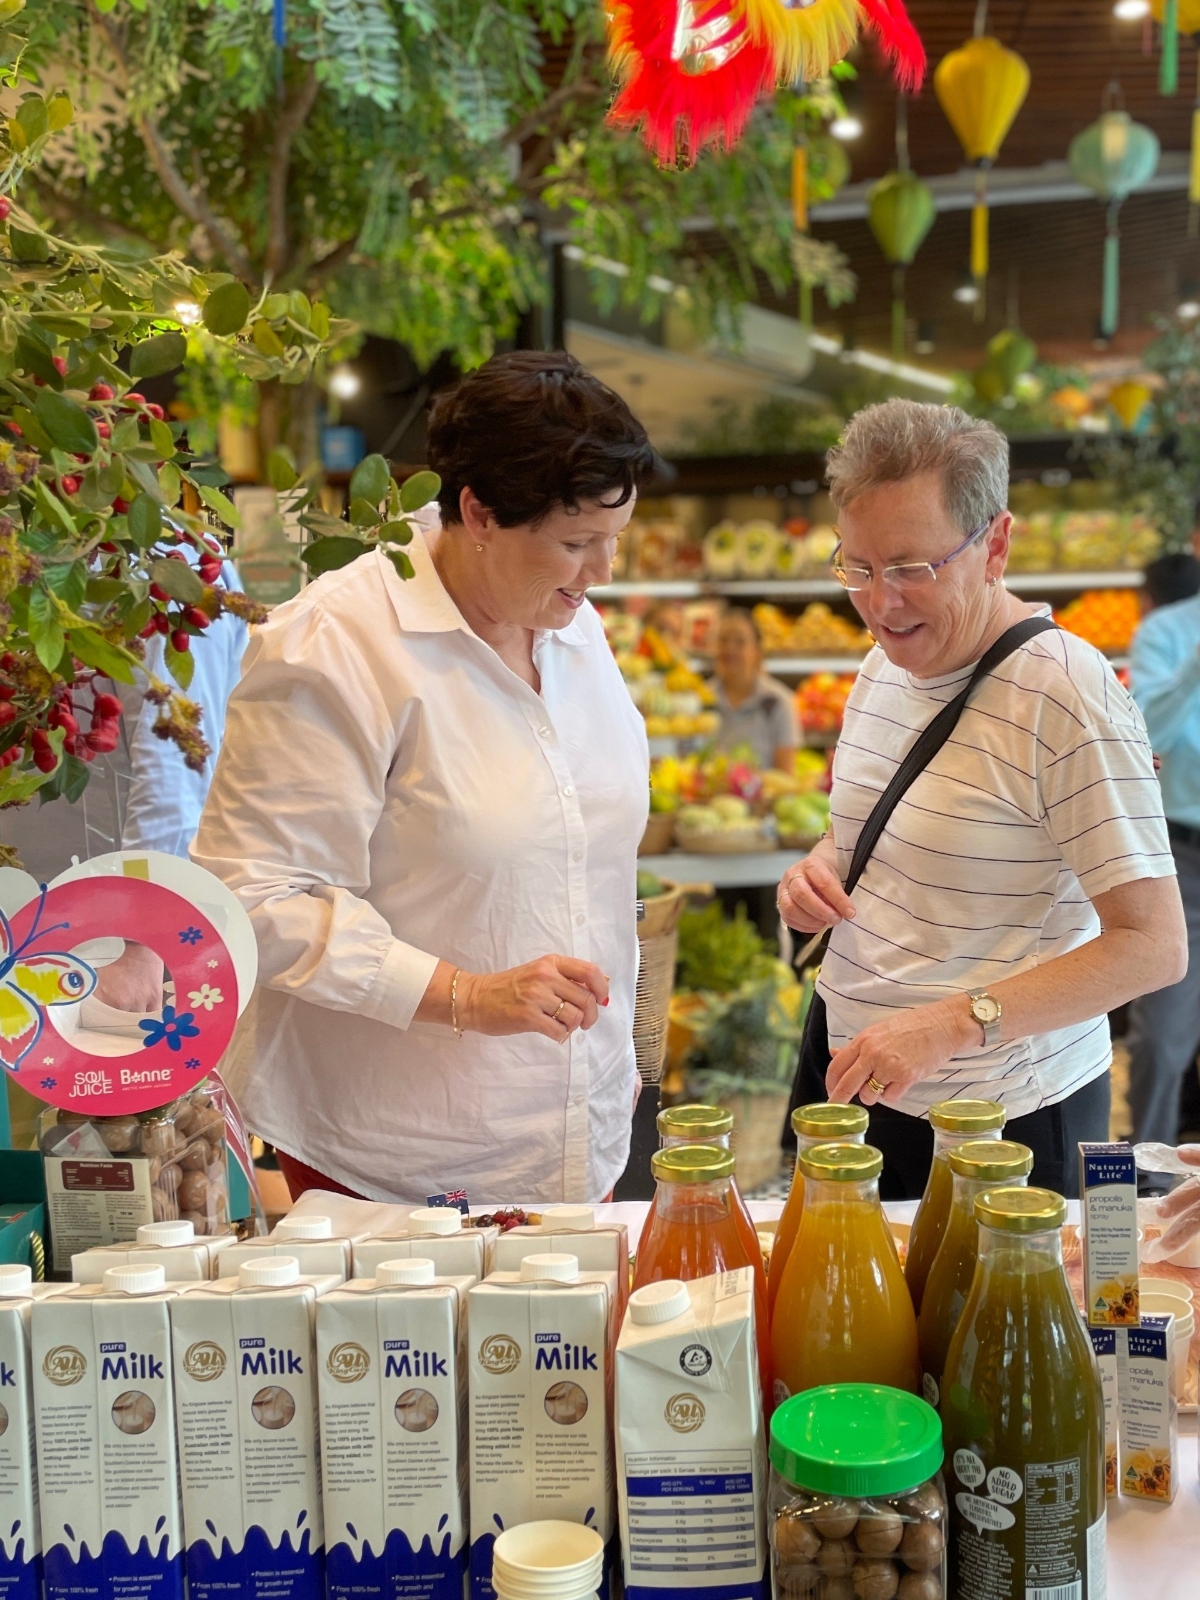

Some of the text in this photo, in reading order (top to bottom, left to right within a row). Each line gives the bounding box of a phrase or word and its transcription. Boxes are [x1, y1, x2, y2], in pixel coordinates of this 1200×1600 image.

[75, 1071, 112, 1084] SOUL
[69, 1082, 113, 1097] JUICE
[1090, 1195, 1122, 1203] propolis
[241, 1339, 263, 1347] pure
[536, 1335, 559, 1343] pure
[1092, 1334, 1113, 1343] ural
[1128, 1337, 1162, 1345] atural
[101, 1343, 124, 1352] pure
[385, 1341, 408, 1350] pure
[1130, 1344, 1152, 1352] Life
[241, 1348, 303, 1376] Milk
[535, 1343, 598, 1371] Milk
[101, 1352, 164, 1380] Milk
[385, 1350, 448, 1378] Milk
[1129, 1368, 1153, 1376] opolis
[1130, 1377, 1163, 1386] manuka
[999, 1470, 1010, 1480] NO
[992, 1477, 1016, 1491] ADDED
[991, 1486, 1015, 1500] SUGAR
[973, 1497, 998, 1512] ARTIFICIAL
[969, 1511, 1002, 1528] PRESERVATIVES
